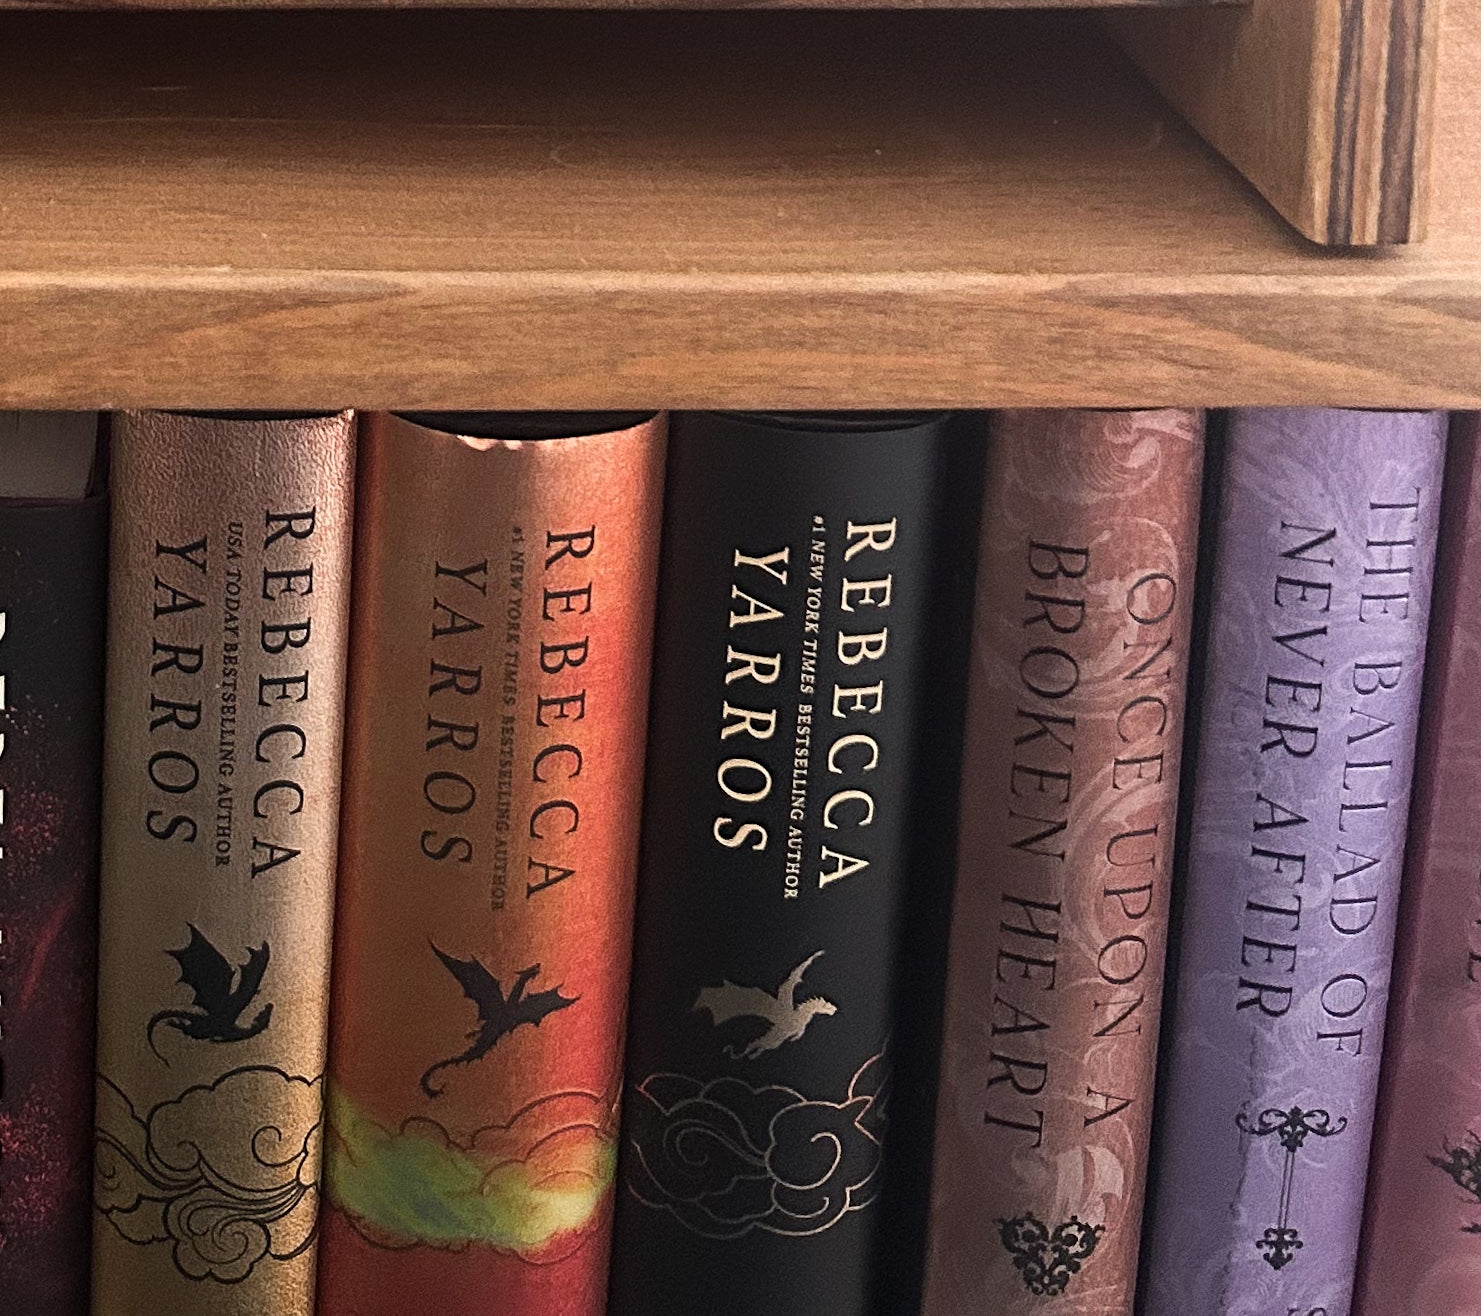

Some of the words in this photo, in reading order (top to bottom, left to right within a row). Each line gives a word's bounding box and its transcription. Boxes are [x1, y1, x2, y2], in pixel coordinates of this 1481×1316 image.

[226, 520, 244, 562] USA
[510, 549, 525, 593] NEW
[809, 538, 826, 579] NEW
[812, 514, 824, 534] #1
[1359, 486, 1422, 624] THE
[224, 565, 241, 636] TODAY
[506, 597, 522, 643] YORK
[805, 585, 823, 634] YORK
[1260, 518, 1339, 761] NEVER
[144, 533, 209, 846] YARROS
[217, 640, 240, 776] BESTSELLING
[249, 506, 317, 880] REBECCA
[420, 559, 489, 865] YARROS
[502, 650, 519, 705] TIMES
[524, 524, 597, 901] REBECCA
[713, 546, 790, 854] YARROS
[799, 637, 818, 696] TIMES
[817, 516, 898, 889] REBECCA
[1007, 539, 1091, 865] BROKEN
[1112, 570, 1179, 792] ONCE
[495, 714, 514, 833] BESTSELLING
[790, 702, 813, 823] BESTSELLING
[1328, 659, 1404, 939] BALLAD
[214, 781, 233, 869] AUTHOR
[490, 837, 509, 912] AUTHOR
[783, 826, 804, 900] AUTHOR
[1091, 821, 1162, 1042] UPON
[1235, 792, 1310, 1021] AFTER
[982, 891, 1063, 1148] HEART
[1317, 971, 1370, 1057] OF
[1083, 1082, 1137, 1133] A
